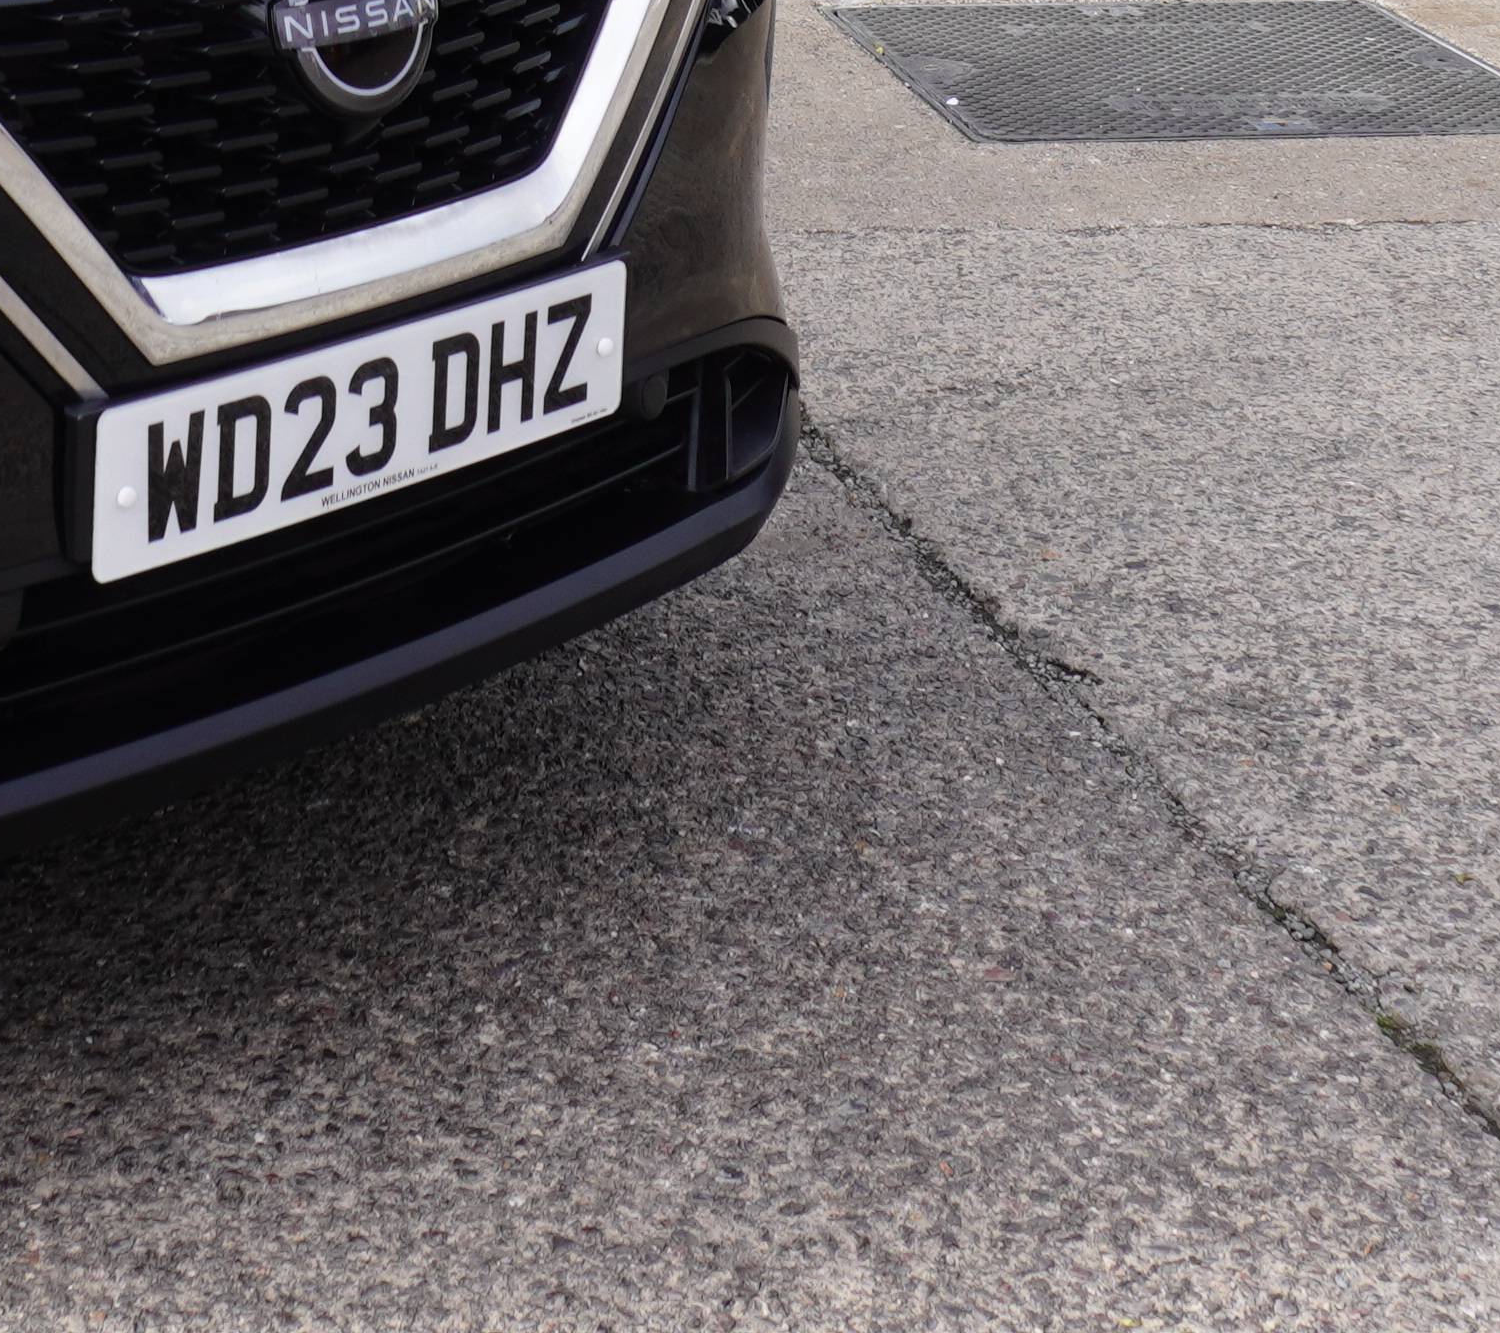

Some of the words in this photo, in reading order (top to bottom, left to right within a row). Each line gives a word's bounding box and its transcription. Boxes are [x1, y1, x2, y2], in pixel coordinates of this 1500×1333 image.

[147, 355, 399, 544] WD23
[428, 293, 593, 454] DHZ
[321, 478, 381, 507] WELLINGTON
[383, 468, 415, 488] NISSAN
